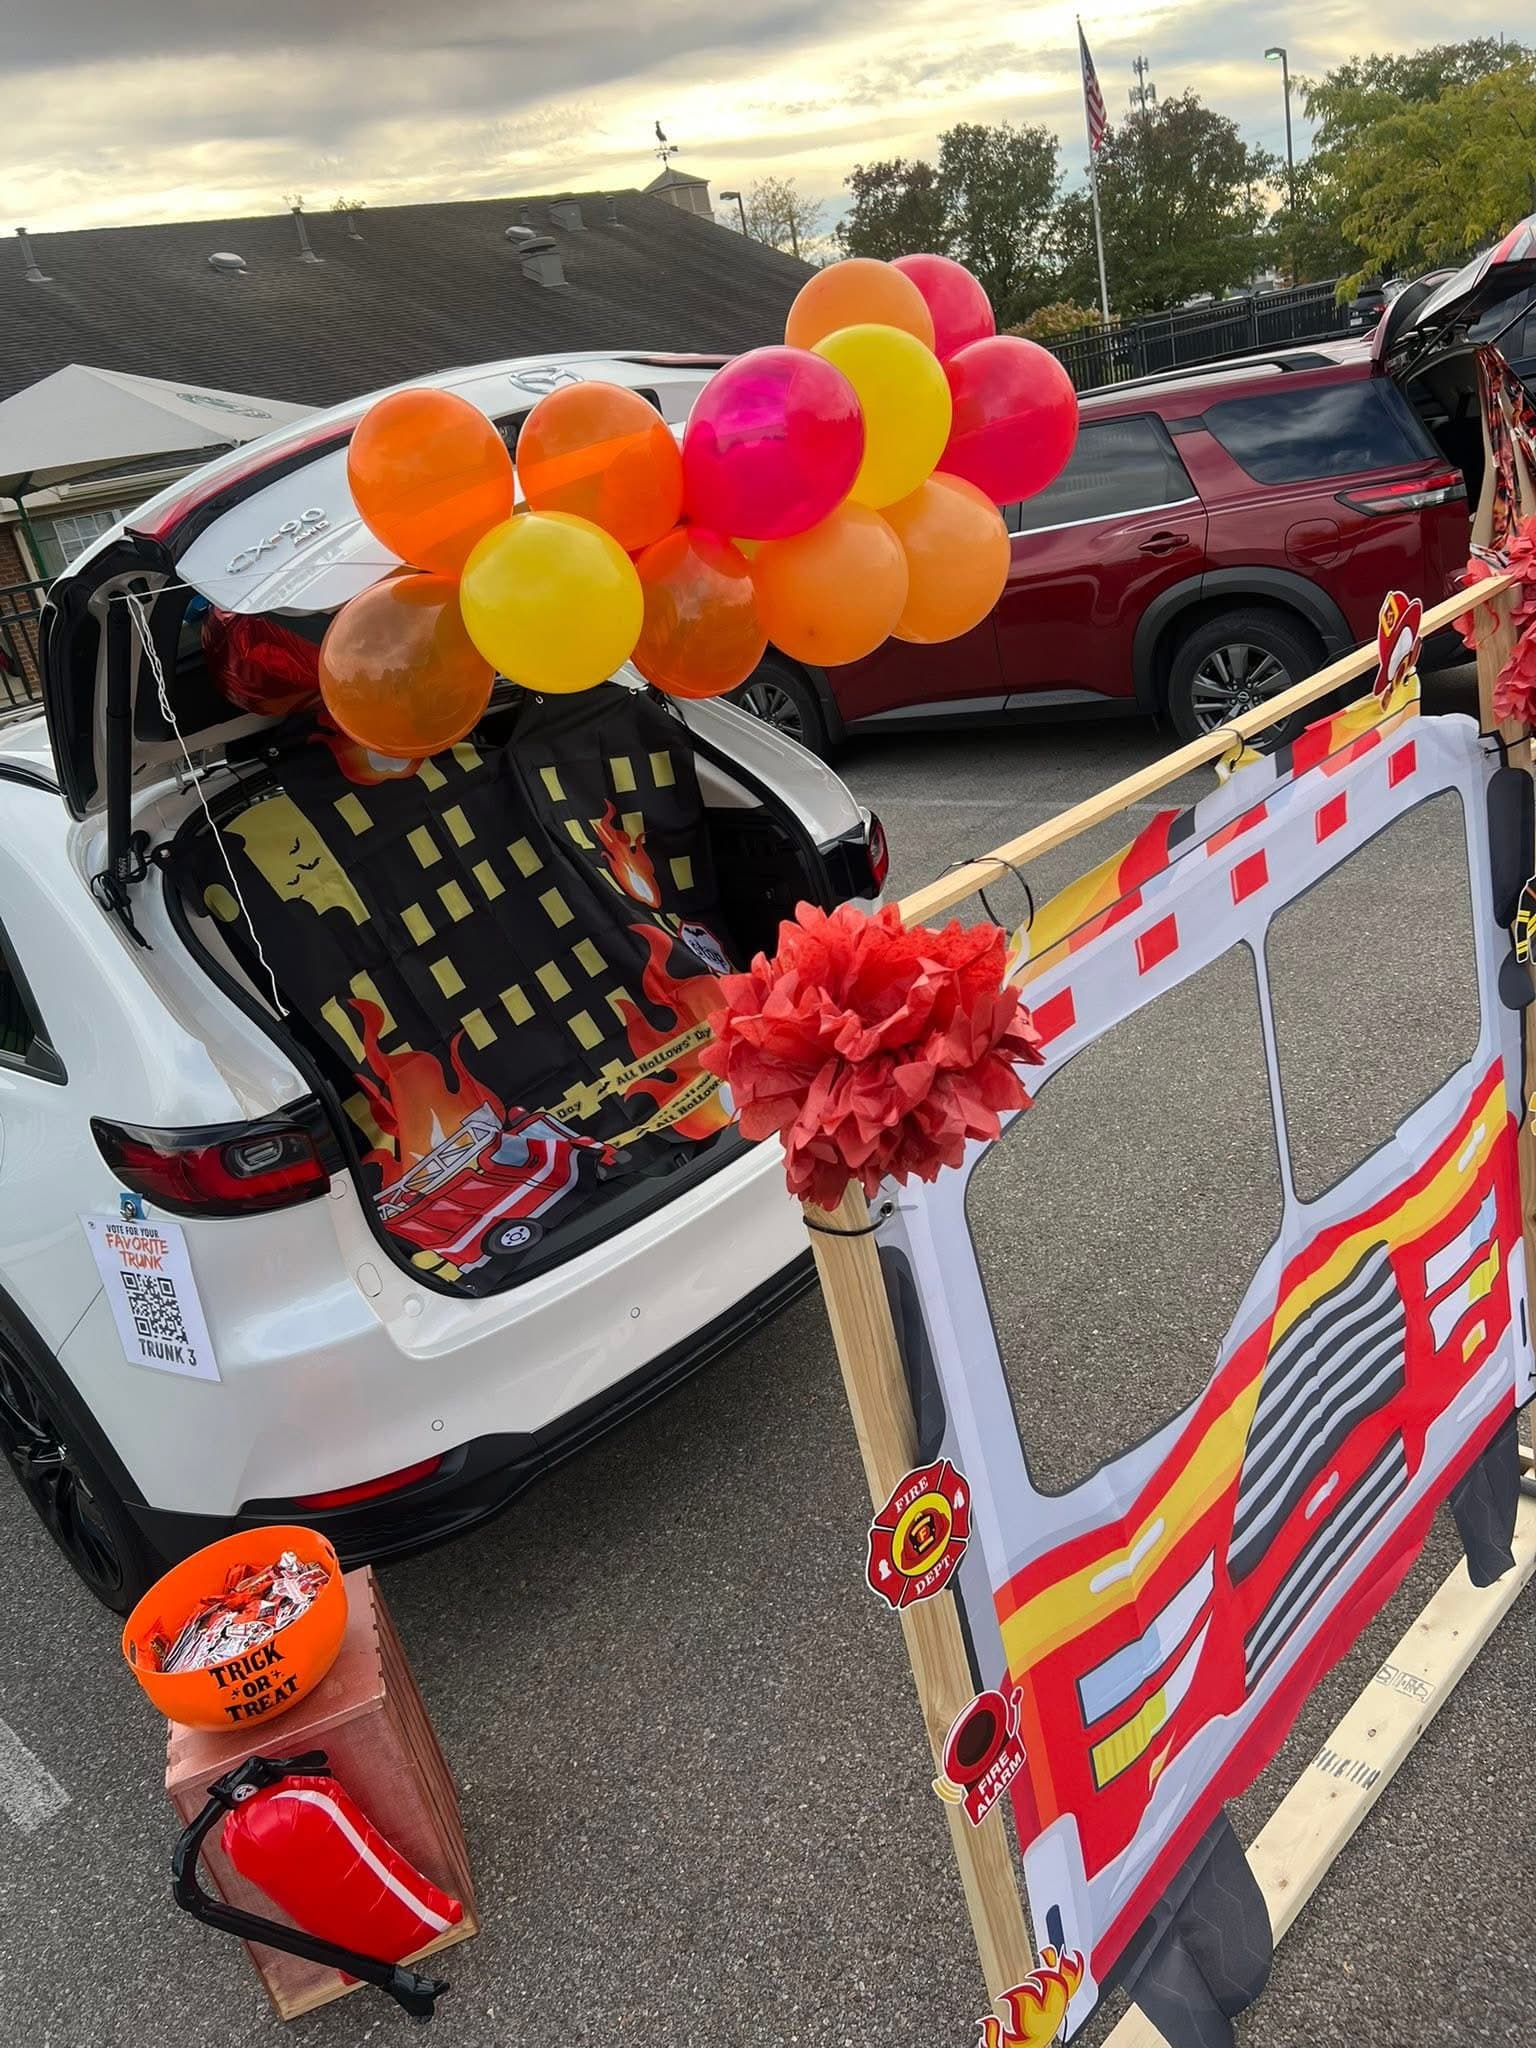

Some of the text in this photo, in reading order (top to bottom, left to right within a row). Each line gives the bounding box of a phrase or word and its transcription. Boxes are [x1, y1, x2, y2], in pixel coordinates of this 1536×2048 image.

[226, 507, 326, 574] CX-90
[556, 1100, 582, 1119] Day
[105, 1233, 169, 1255] FAVORITE
[106, 1224, 160, 1238] VOTE FOR YOUR
[119, 1250, 164, 1272] TRUNK
[138, 1338, 197, 1366] TRUNK 3
[894, 1476, 929, 1514] FIRE
[914, 1555, 955, 1595] DEPT.
[209, 1639, 285, 1690] TRICK
[225, 1674, 300, 1722] TREAT
[242, 1675, 272, 1698] OR
[977, 1753, 1022, 1820] ALARM
[978, 1750, 1010, 1795] FIRE
